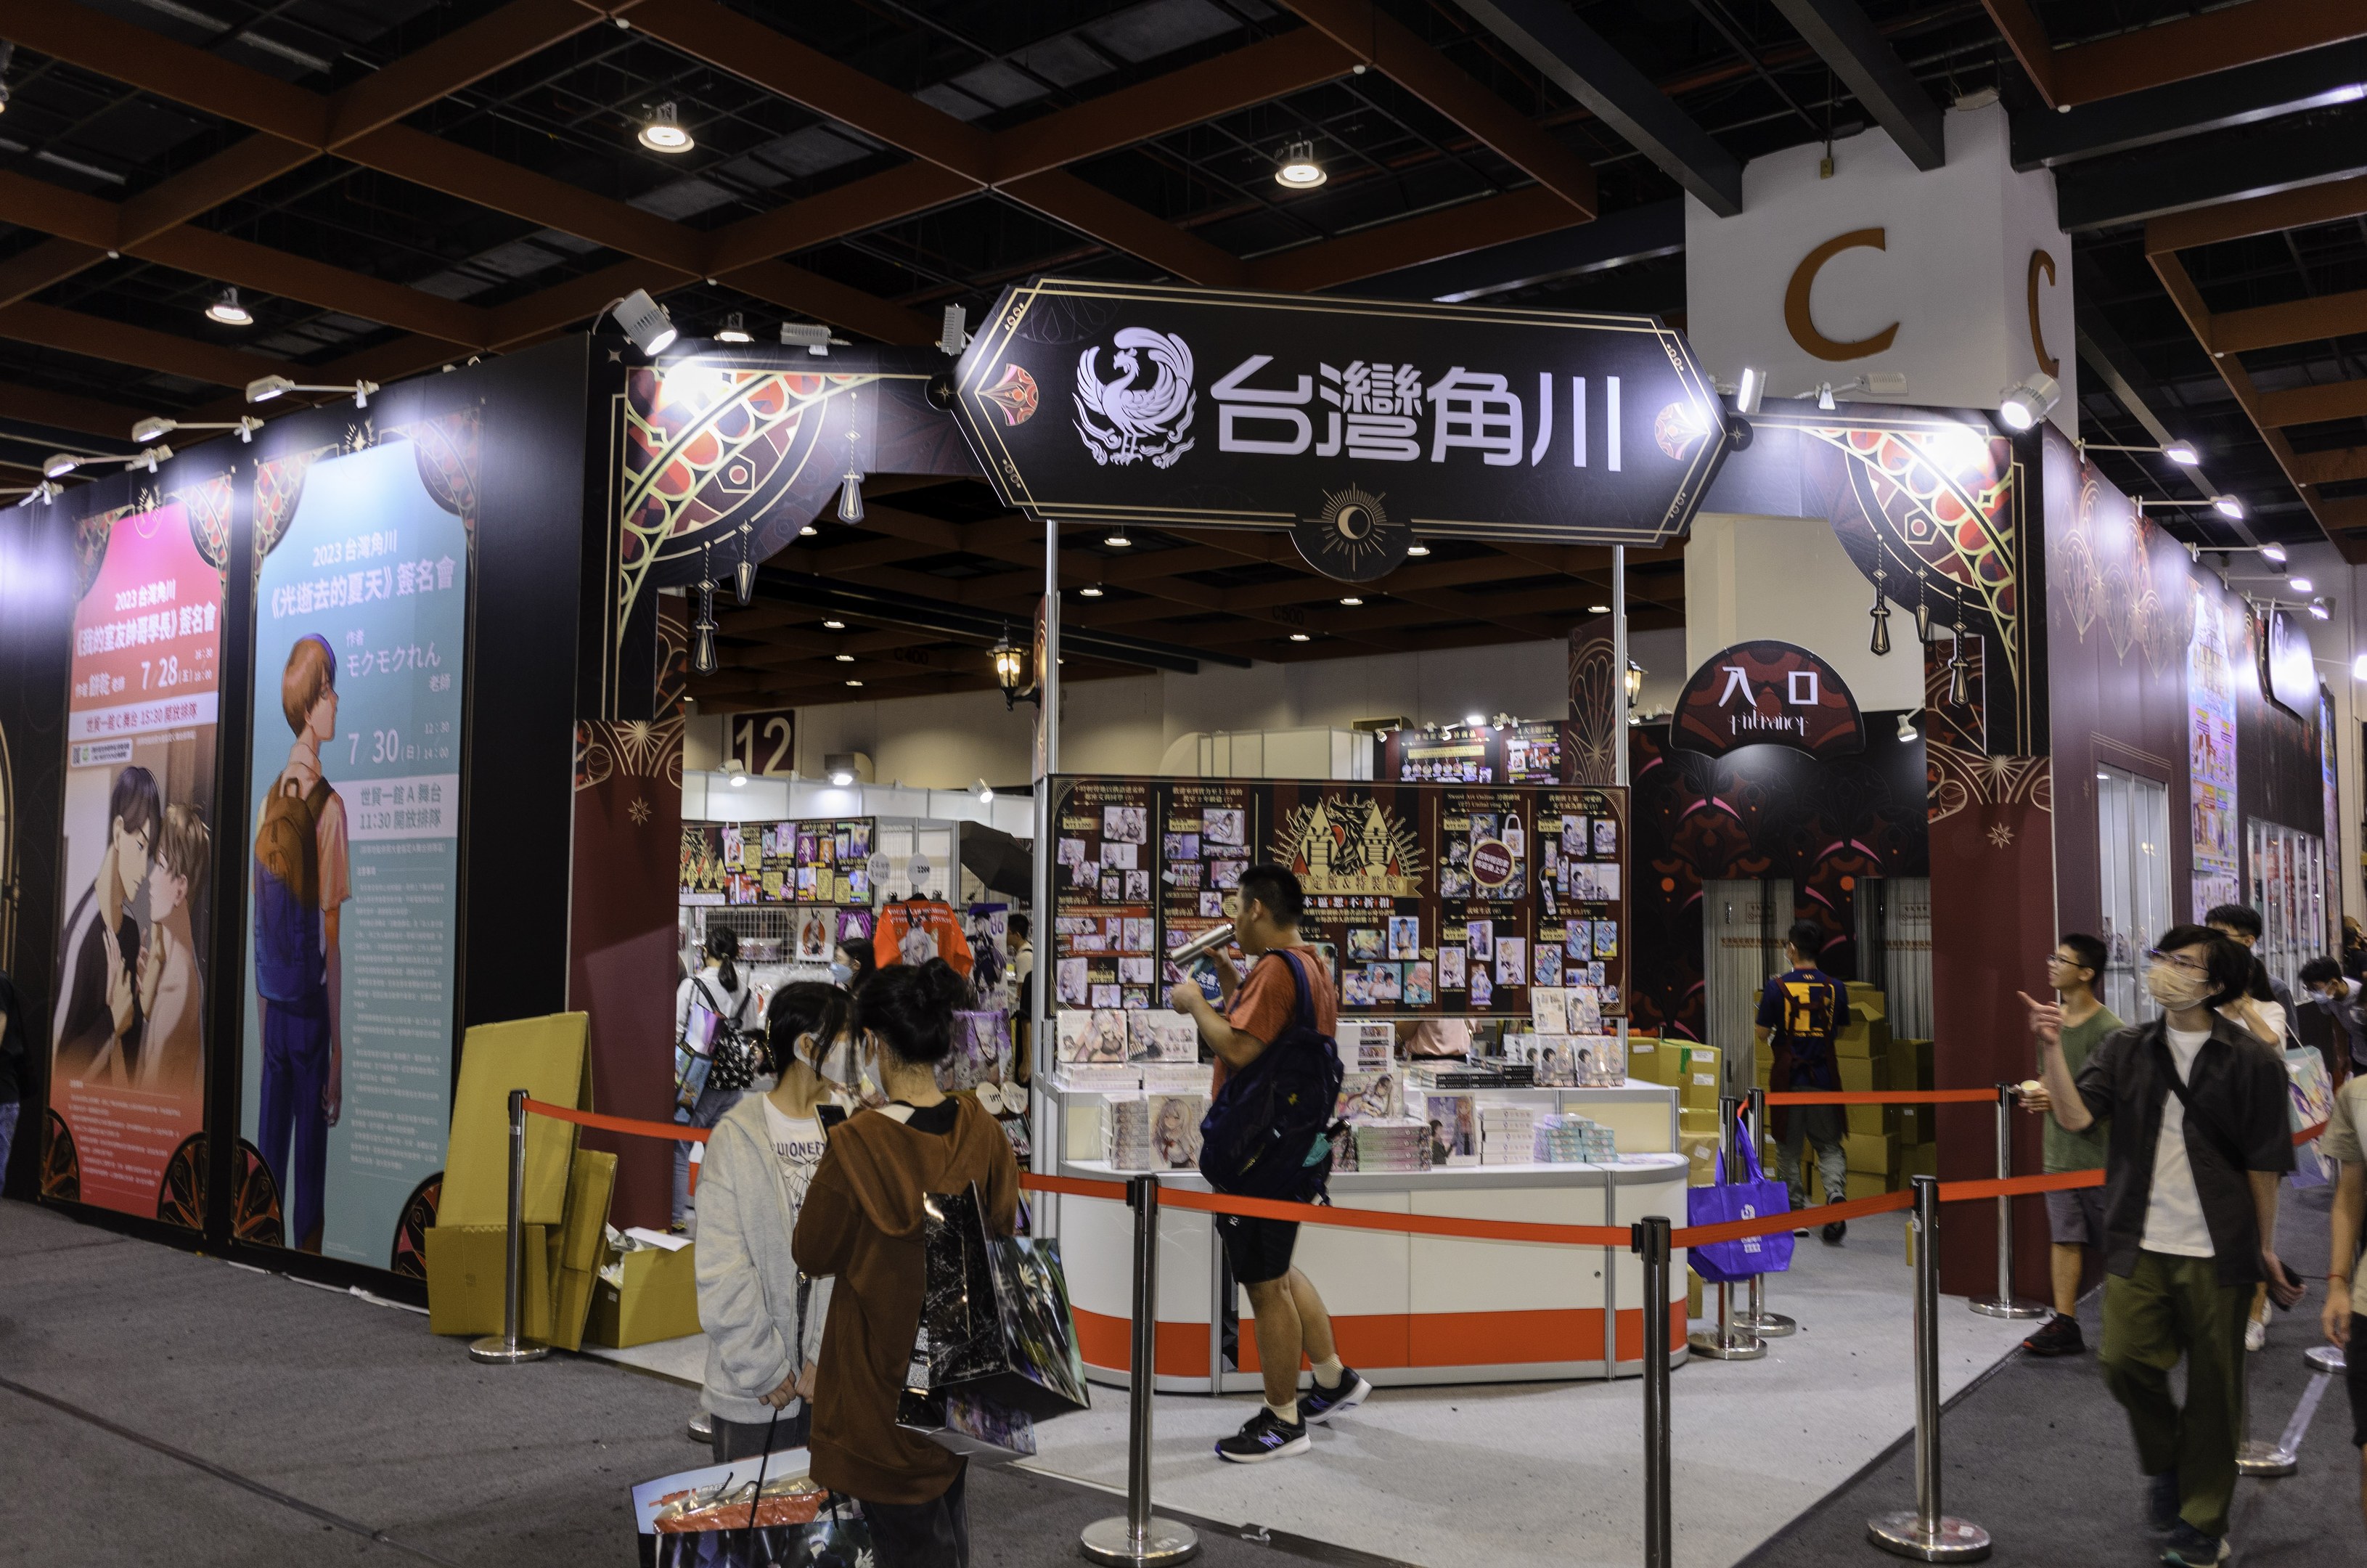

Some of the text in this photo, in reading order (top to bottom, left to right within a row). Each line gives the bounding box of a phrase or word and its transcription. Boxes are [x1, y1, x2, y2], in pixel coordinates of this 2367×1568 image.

[1784, 228, 1900, 362] C
[2028, 250, 2059, 379] C
[1210, 355, 1621, 471] 台灣角川
[313, 529, 397, 567] 2023 台灣角川
[115, 579, 176, 611] 2023 台灣角川
[346, 642, 441, 677] モクモクれん
[1718, 666, 1818, 707] 入口
[736, 716, 791, 777] 12
[360, 785, 405, 807] 世貿一館
[417, 782, 442, 804] 舞台
[359, 807, 442, 830] 11:30 開放排隊
